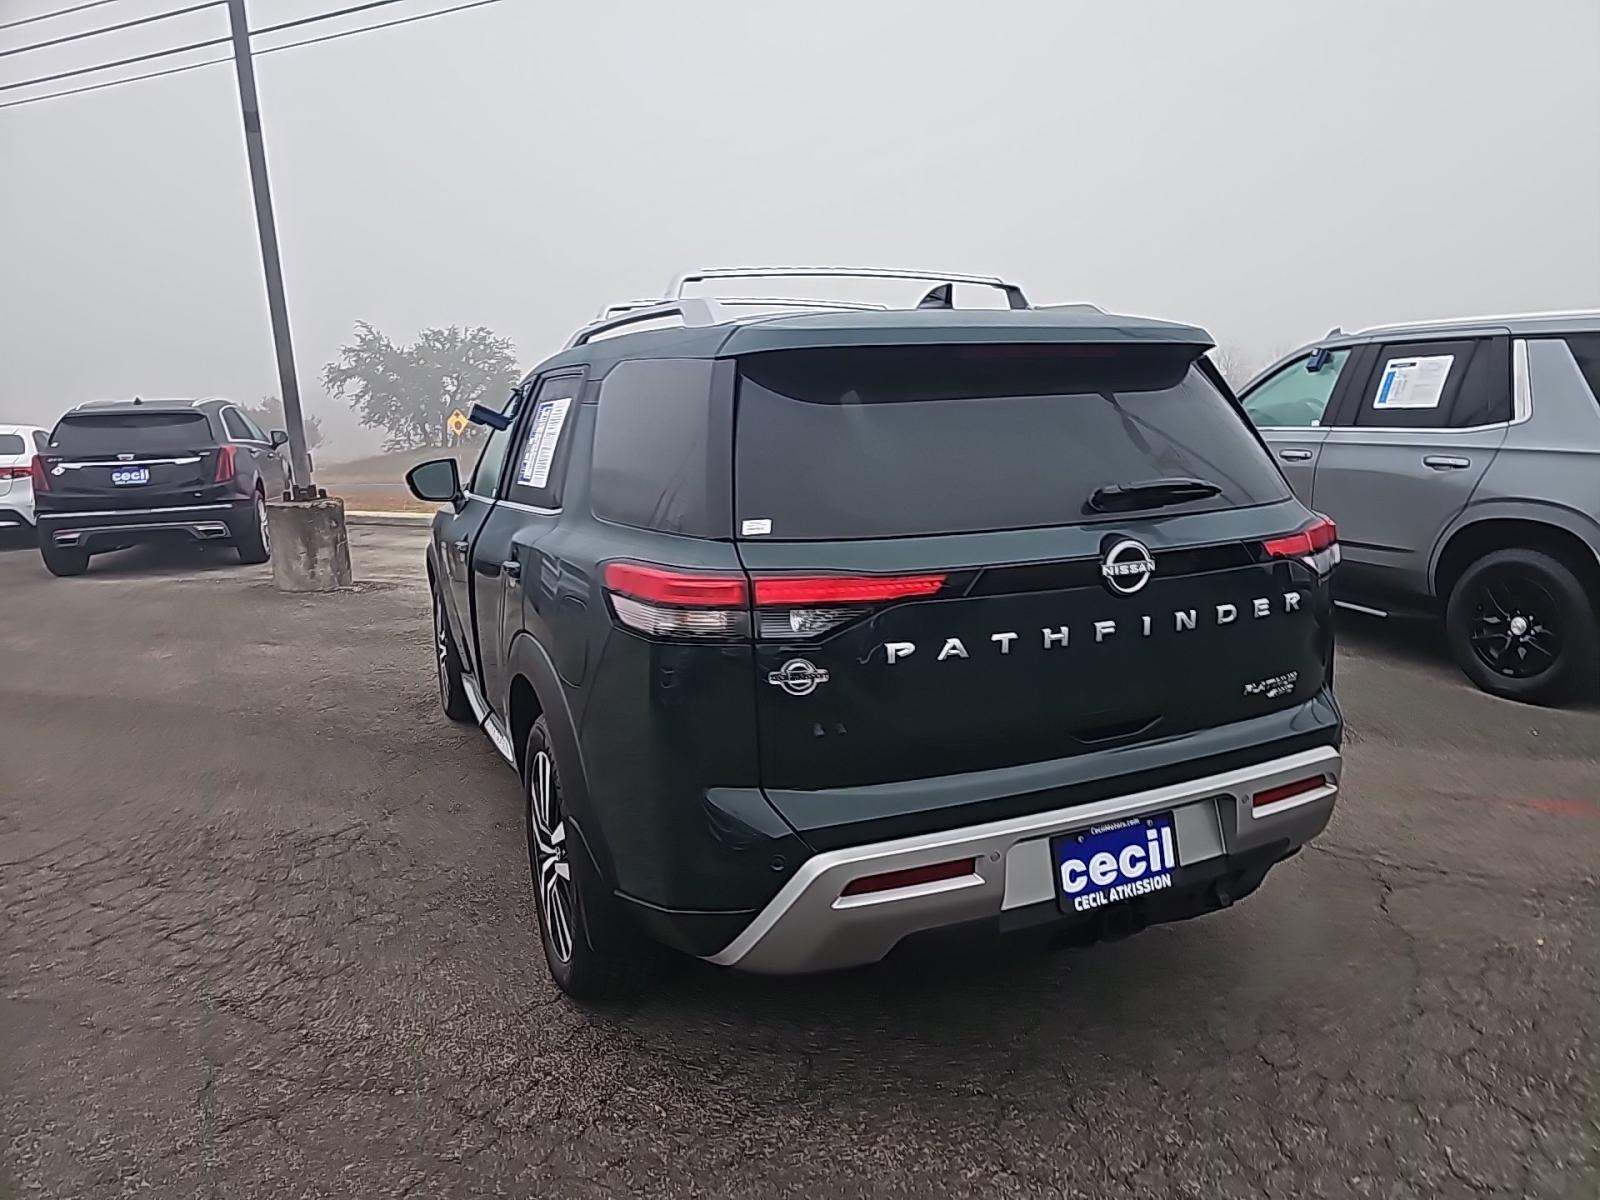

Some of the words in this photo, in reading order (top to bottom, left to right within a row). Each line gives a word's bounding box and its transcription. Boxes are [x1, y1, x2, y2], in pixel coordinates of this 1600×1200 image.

[1101, 560, 1156, 576] NISSAN
[884, 591, 1301, 664] PATHFINDER
[1060, 826, 1175, 893] cecil
[1074, 890, 1108, 912] CECIL
[1109, 873, 1172, 902] ATKISSION
